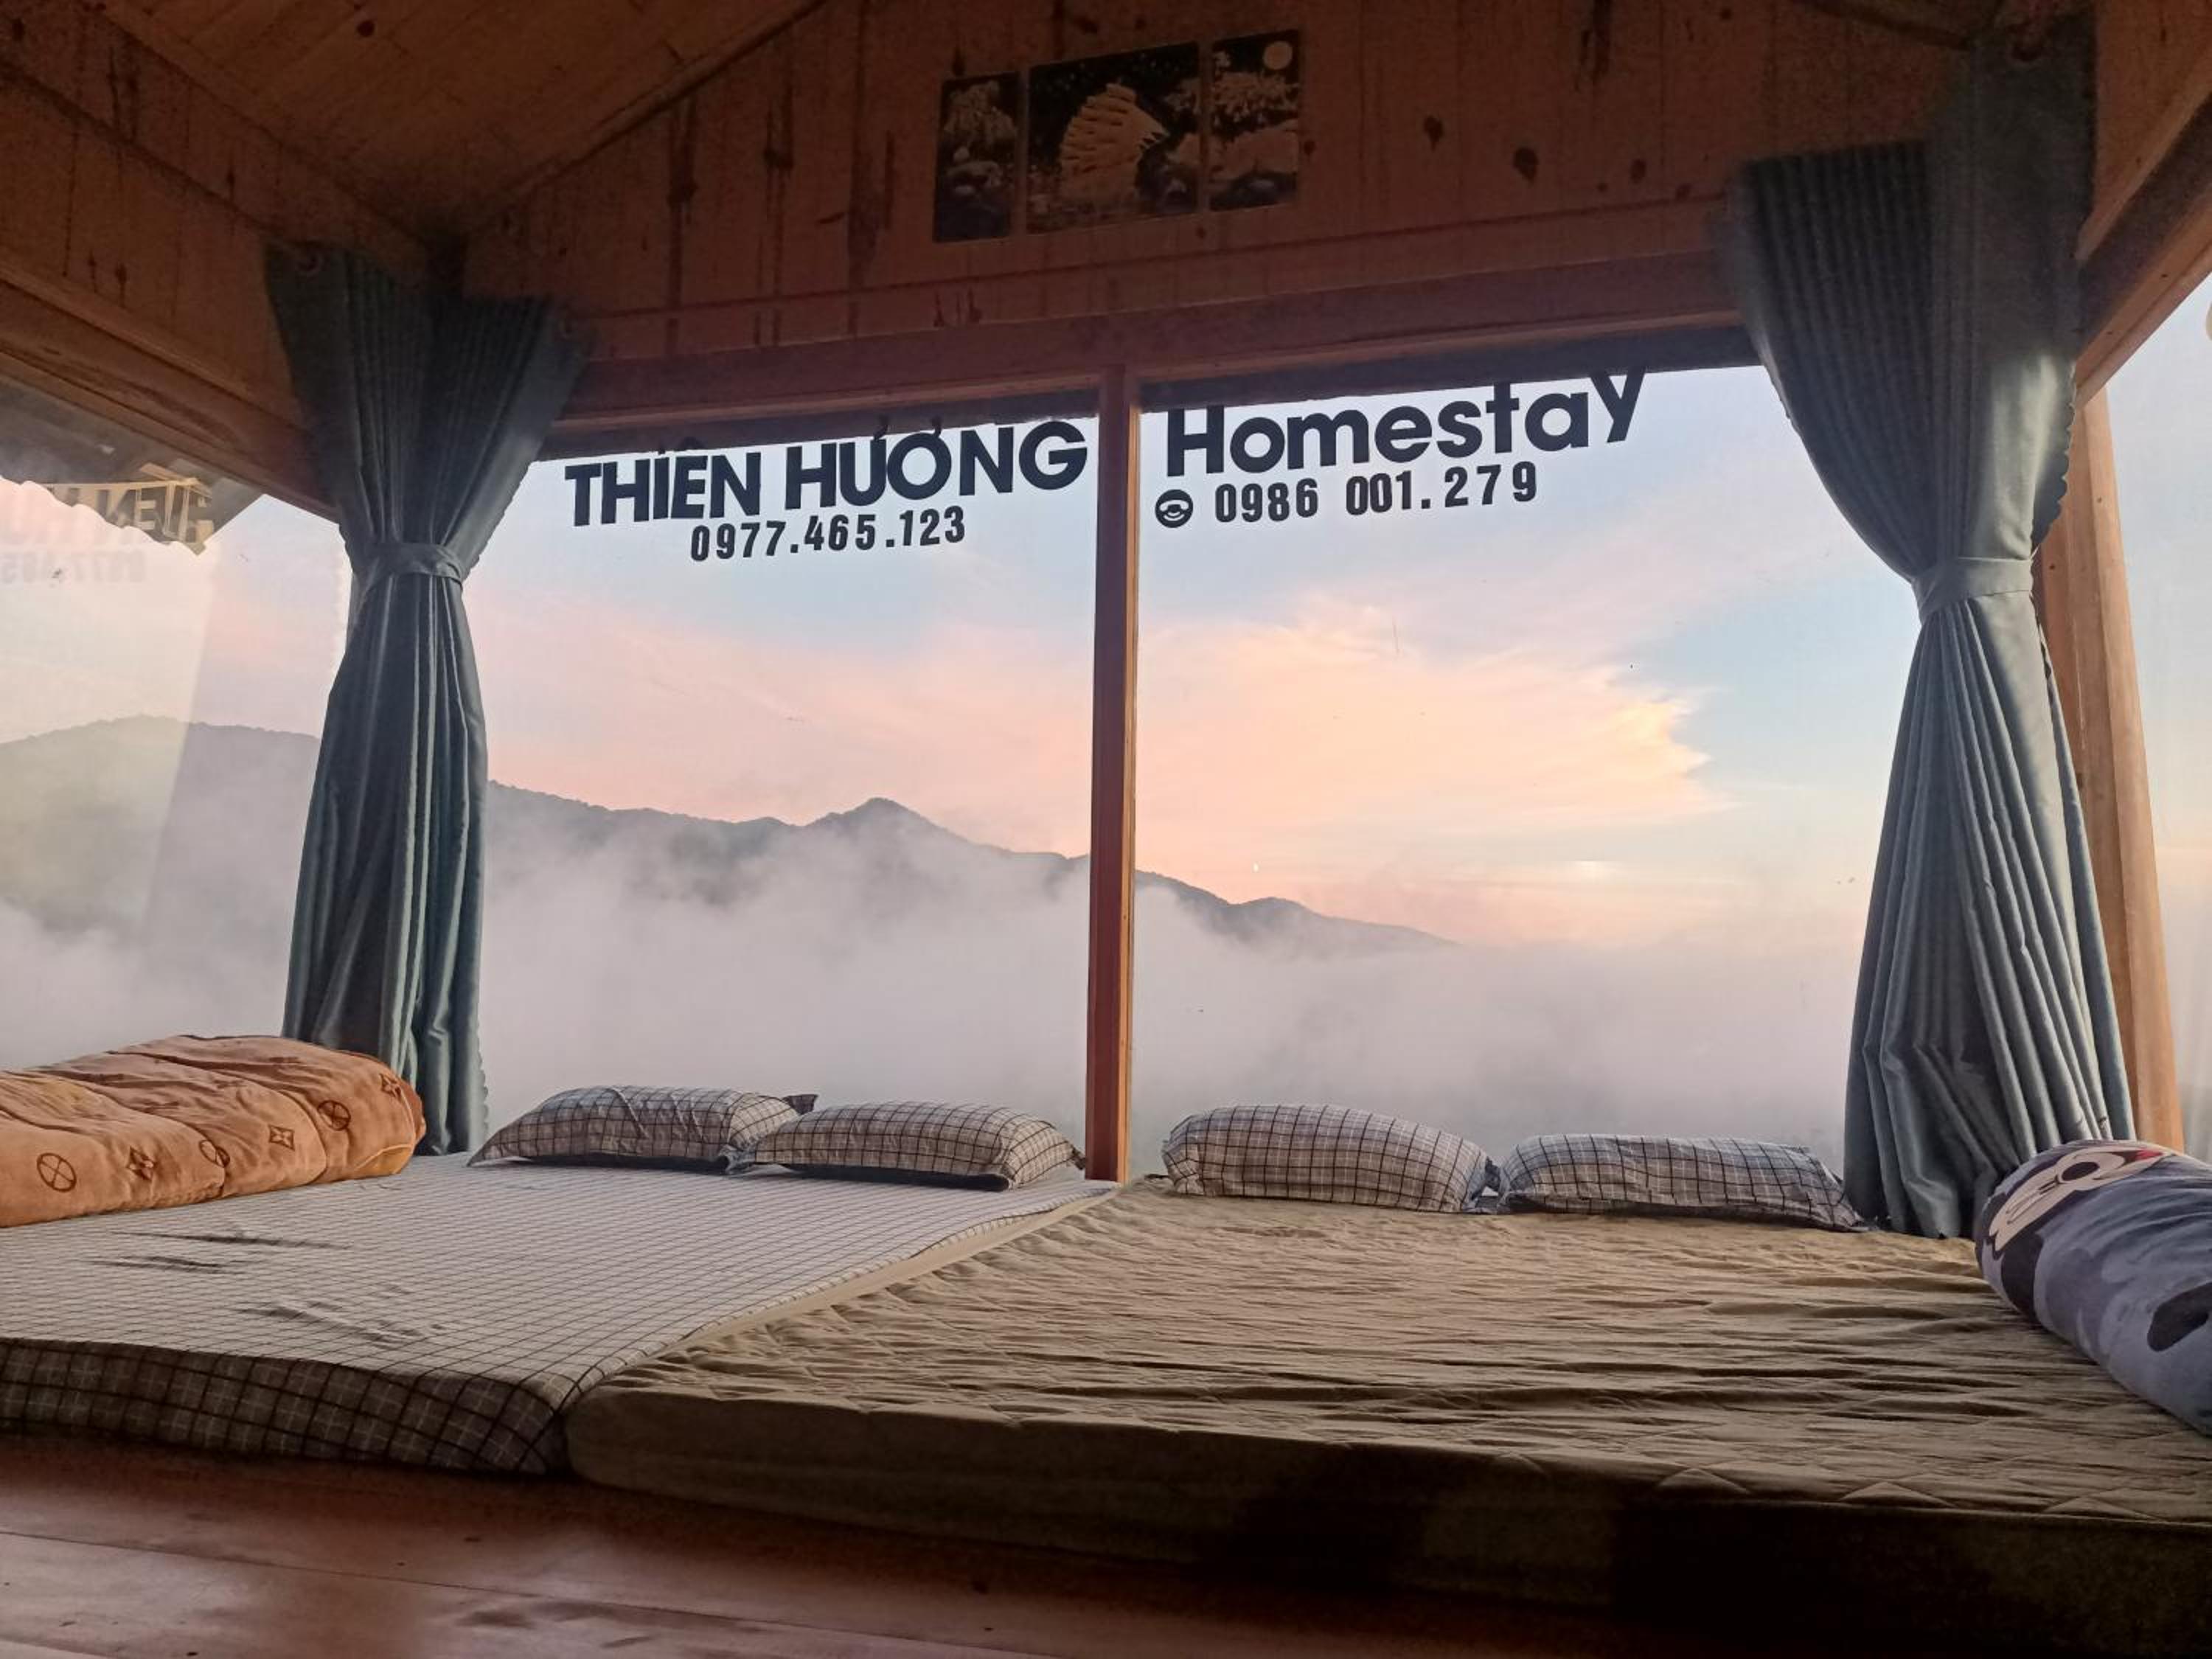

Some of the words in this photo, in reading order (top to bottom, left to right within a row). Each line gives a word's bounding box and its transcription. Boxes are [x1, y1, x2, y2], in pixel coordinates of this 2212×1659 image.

[1166, 366, 1646, 477] Homestay
[1214, 477, 1318, 523] 0986
[1346, 461, 1537, 515] 001.279
[690, 505, 966, 562] 0977.465.123
